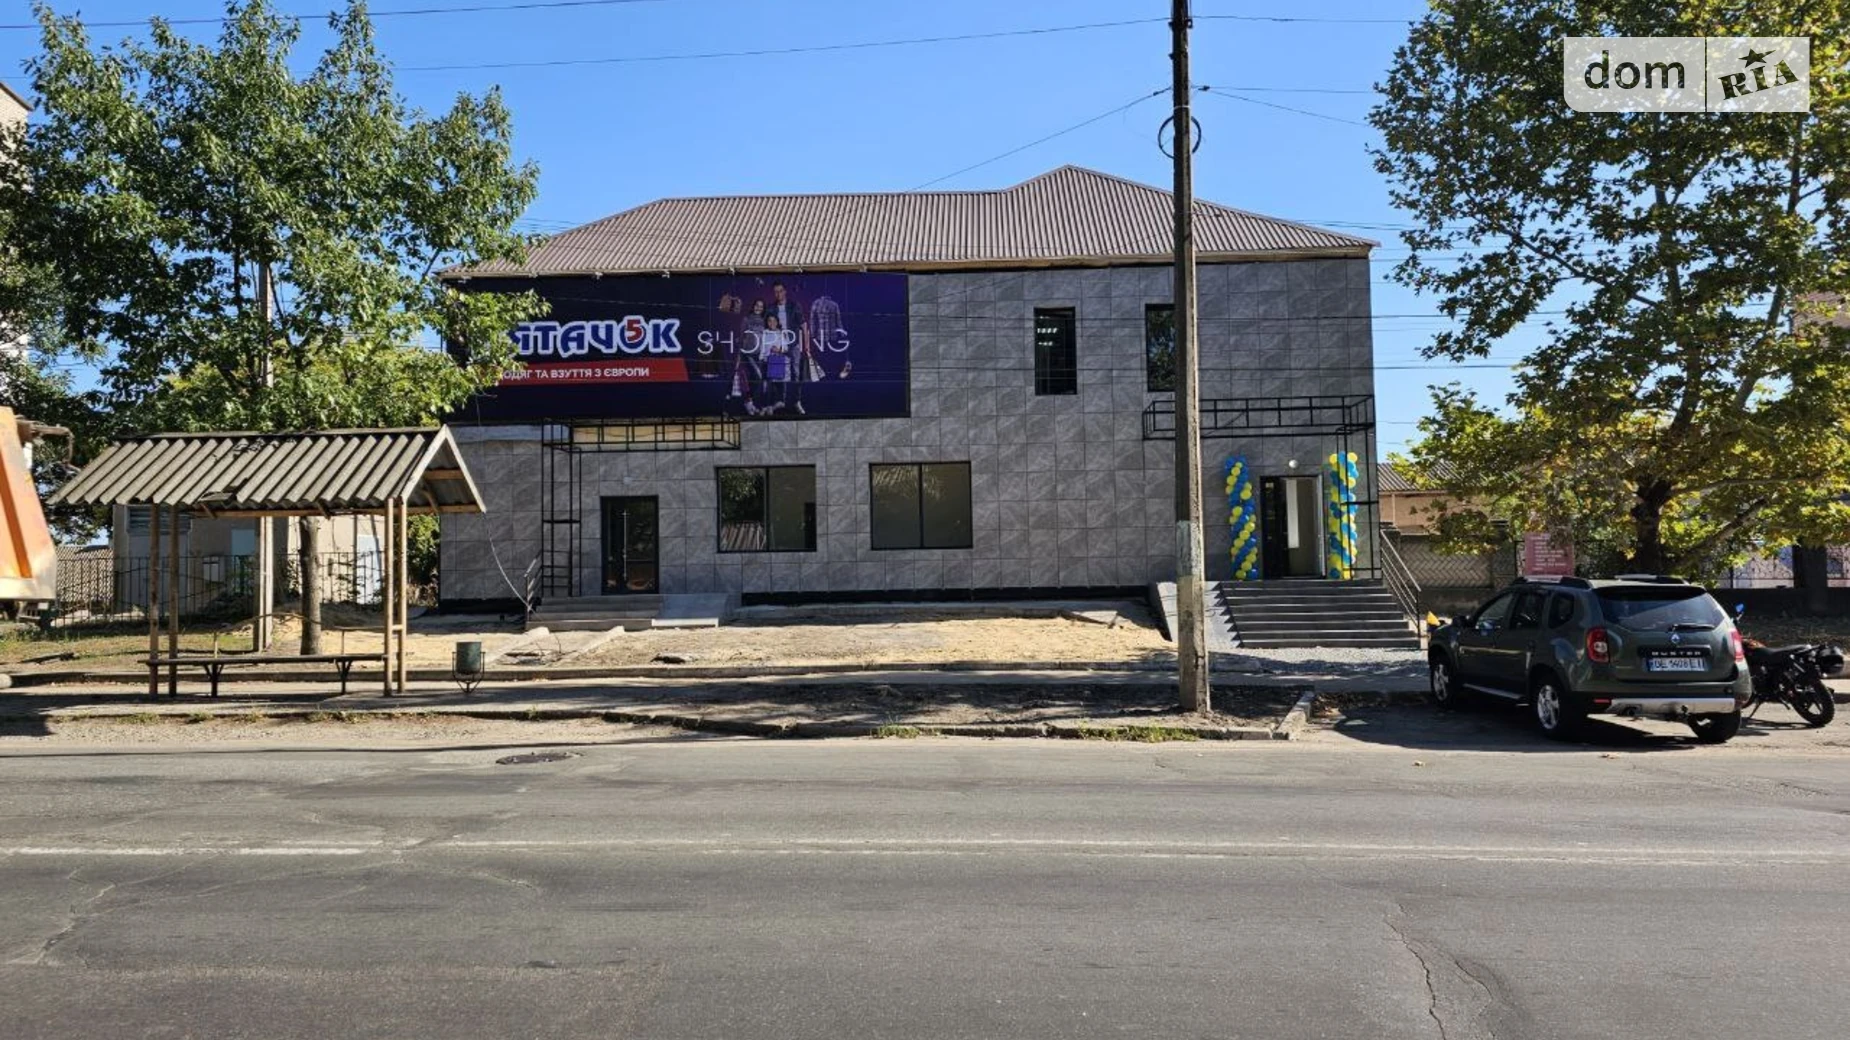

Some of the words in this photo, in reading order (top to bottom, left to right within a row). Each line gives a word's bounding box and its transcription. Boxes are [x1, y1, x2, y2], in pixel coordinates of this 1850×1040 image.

[507, 317, 682, 358] ЯТАЧОК
[697, 329, 850, 354] SHOPPING
[502, 369, 532, 380] ОДЯГ
[535, 370, 549, 379] ТА
[551, 368, 592, 379] ВЗУТТЯ
[604, 367, 650, 377] ЄВРОПИ
